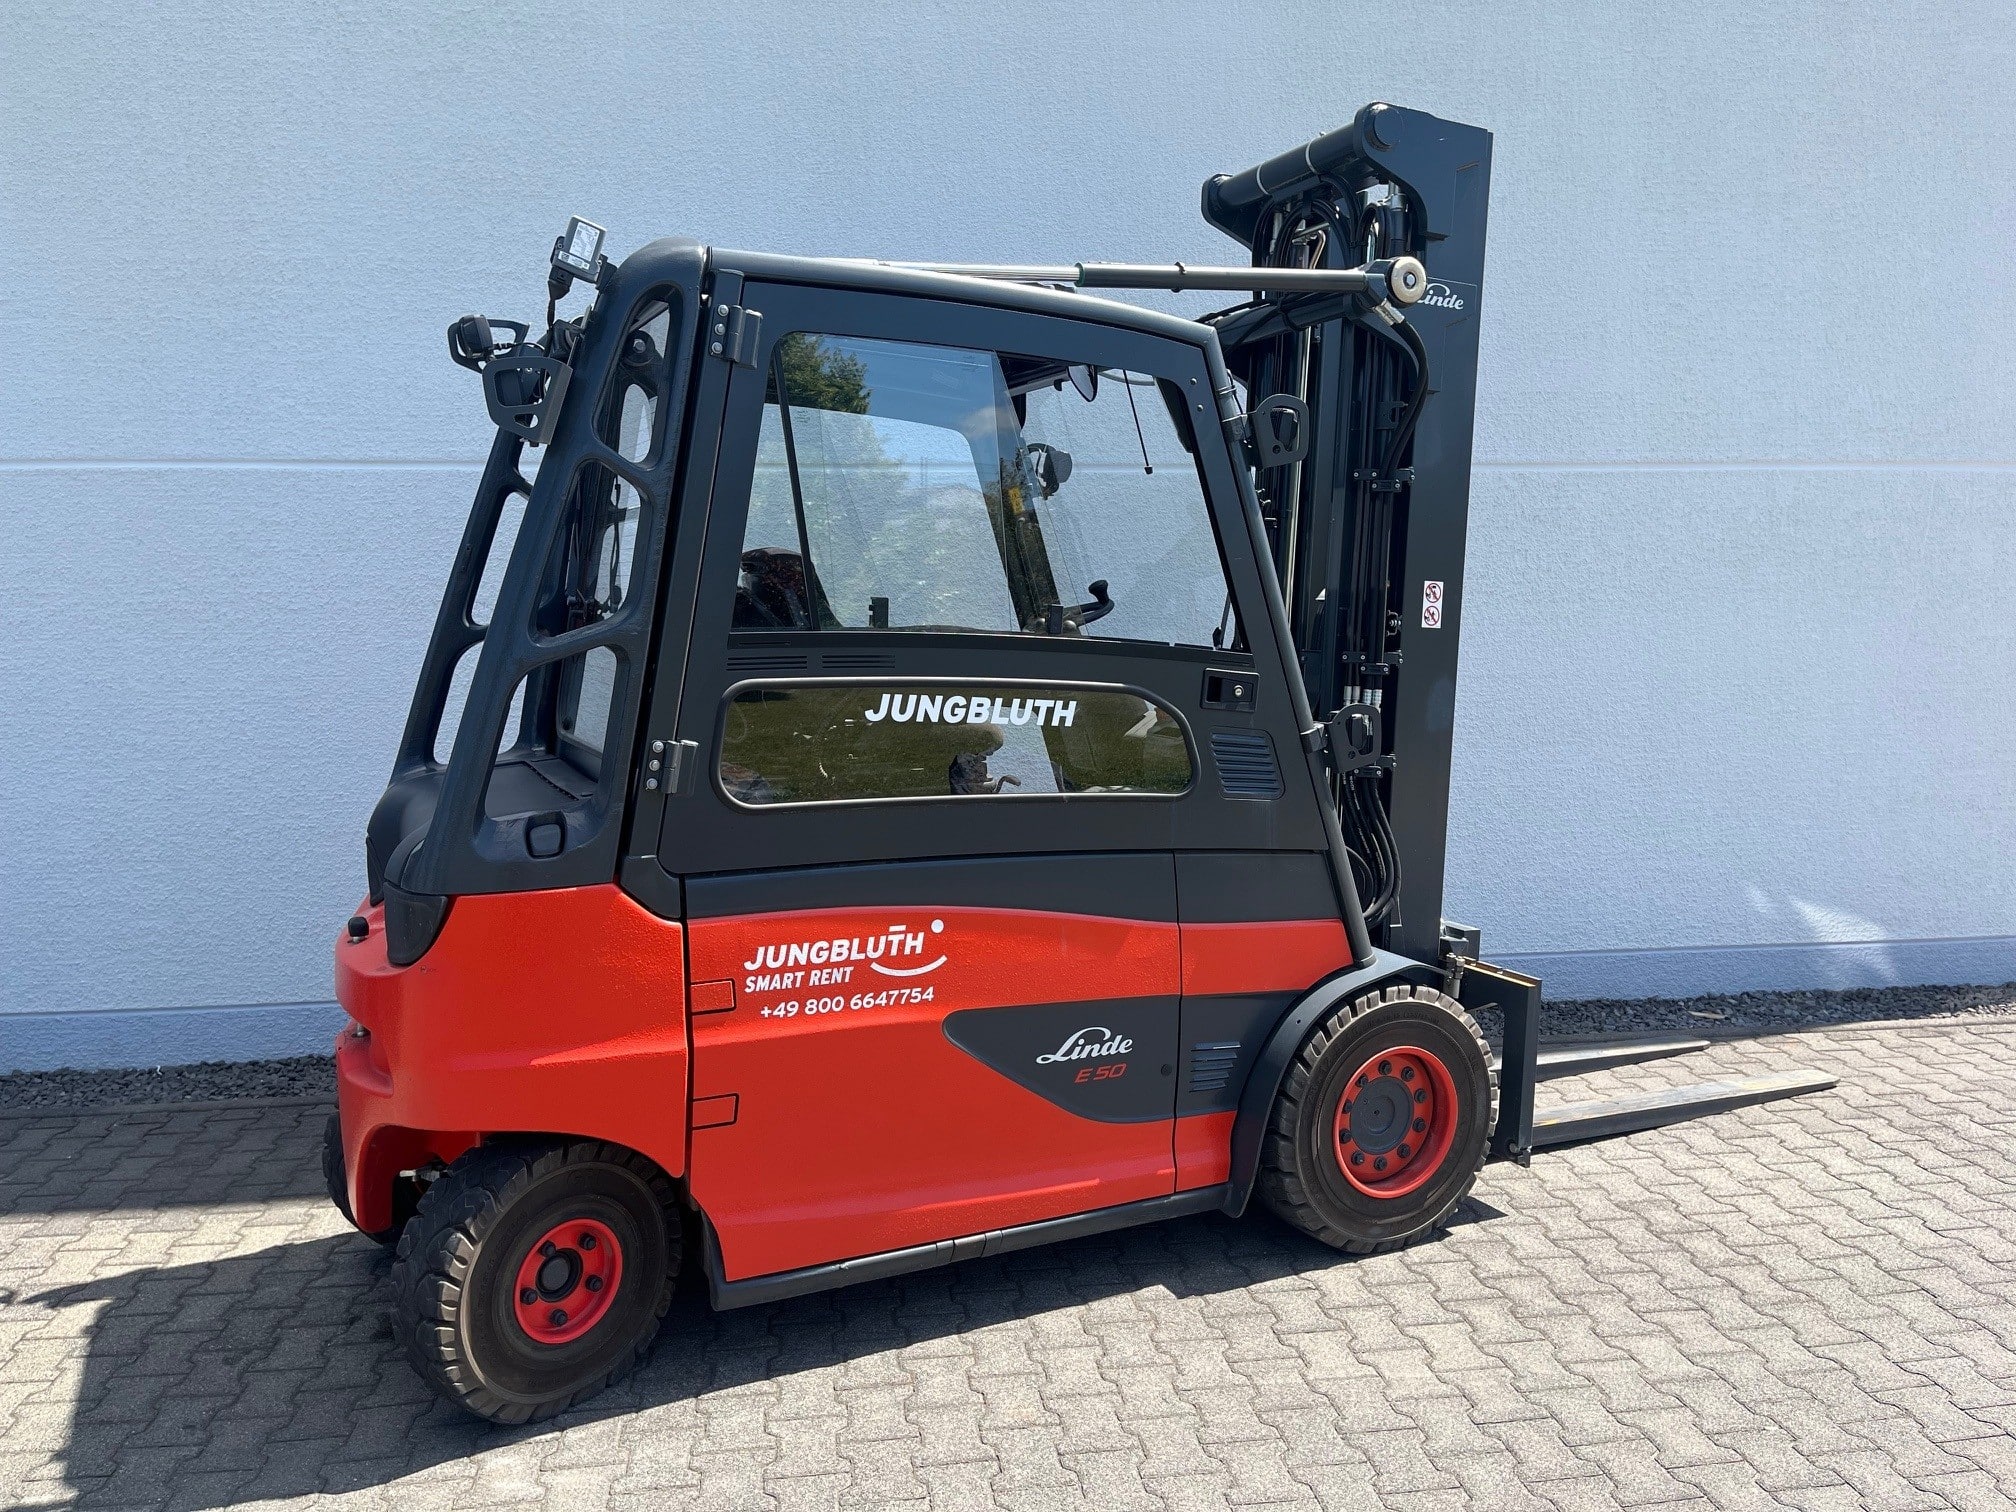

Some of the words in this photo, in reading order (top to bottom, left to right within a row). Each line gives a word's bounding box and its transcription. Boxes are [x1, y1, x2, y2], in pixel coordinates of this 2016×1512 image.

[864, 693, 1077, 727] JUNGBLUTH
[743, 930, 924, 971] JUNGBLUTH
[744, 971, 805, 993] SMART
[809, 966, 855, 986] RENT
[760, 1001, 799, 1018] +49
[804, 996, 845, 1015] 800
[850, 986, 934, 1010] 6647754
[1036, 1026, 1133, 1064] Linde
[1094, 1063, 1128, 1080] 50
